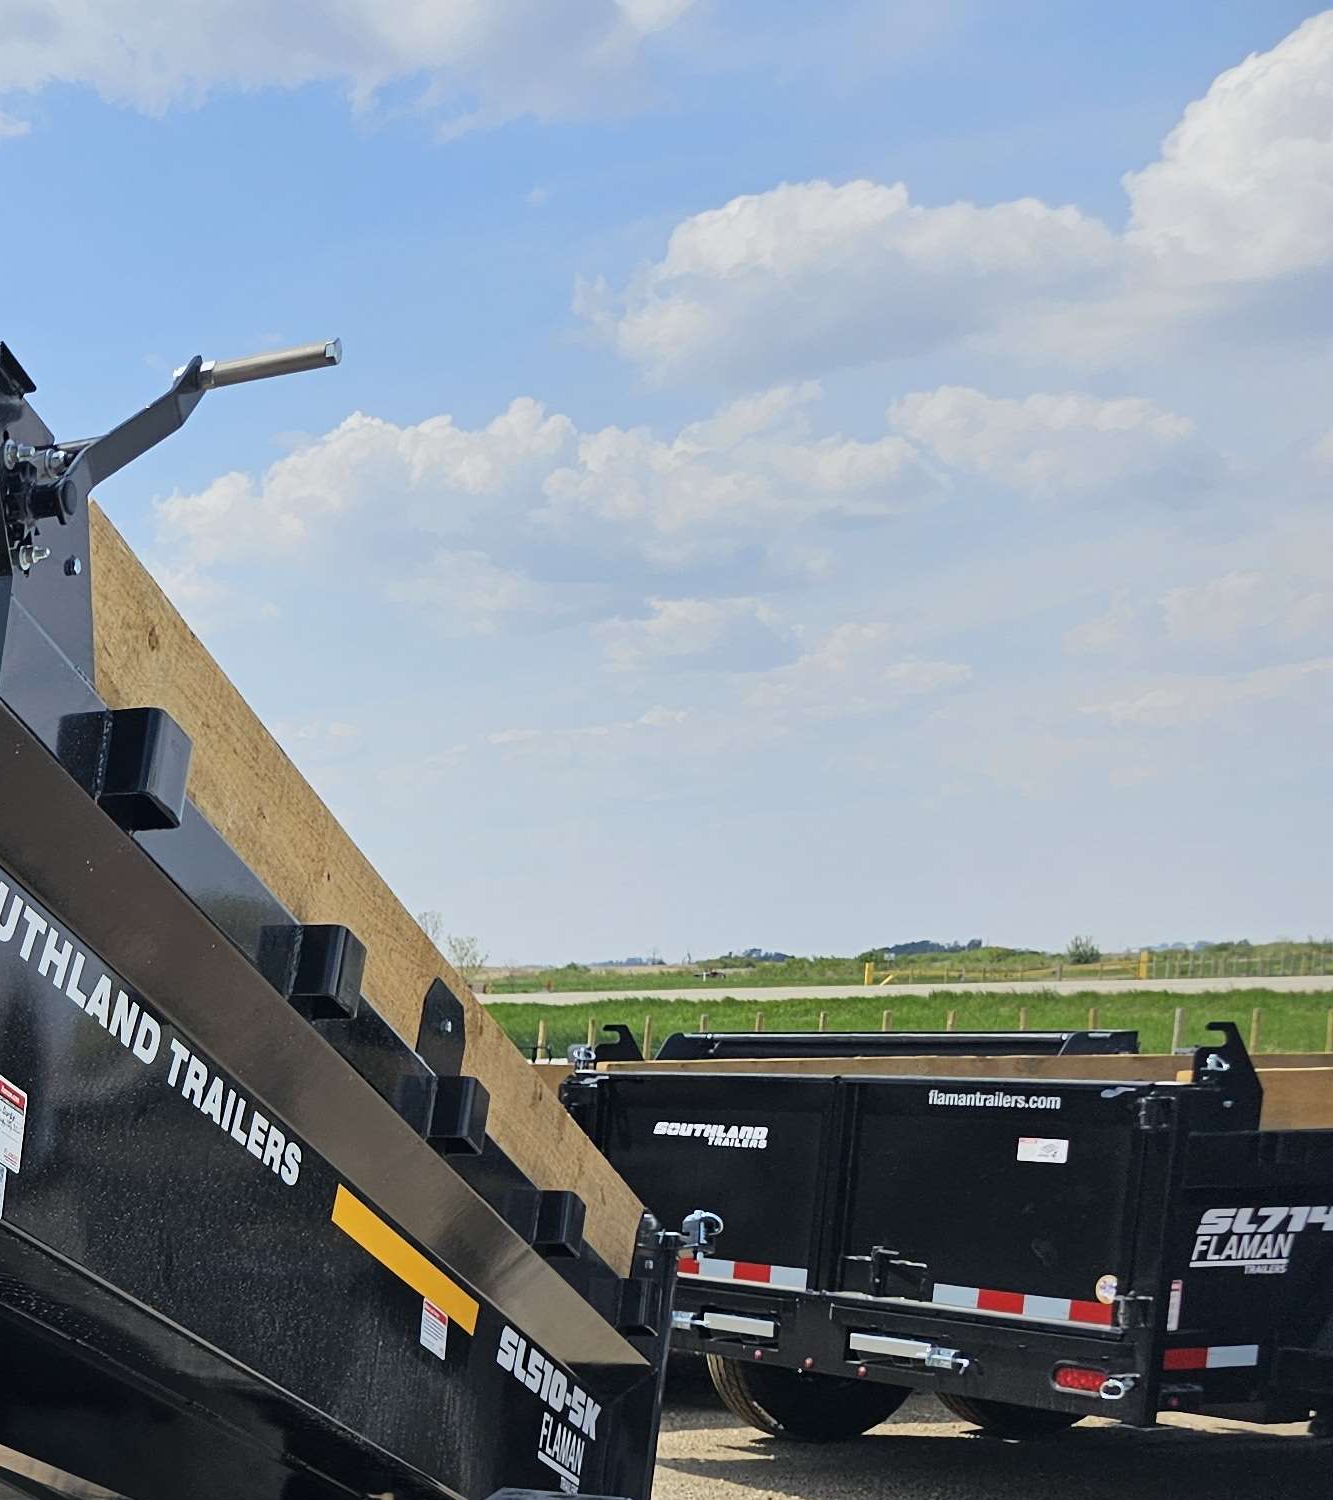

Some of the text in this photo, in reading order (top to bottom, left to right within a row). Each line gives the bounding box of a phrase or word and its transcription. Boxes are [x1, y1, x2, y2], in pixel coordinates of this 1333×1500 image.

[928, 1089, 1061, 1110] flamantrailers.com
[167, 1038, 302, 1186] TRAILERS
[653, 1121, 768, 1140] SOUTHLAND
[707, 1137, 767, 1149] TRAILERS
[1191, 1233, 1295, 1261] FLAMAN
[538, 1412, 585, 1476] FLAMAN
